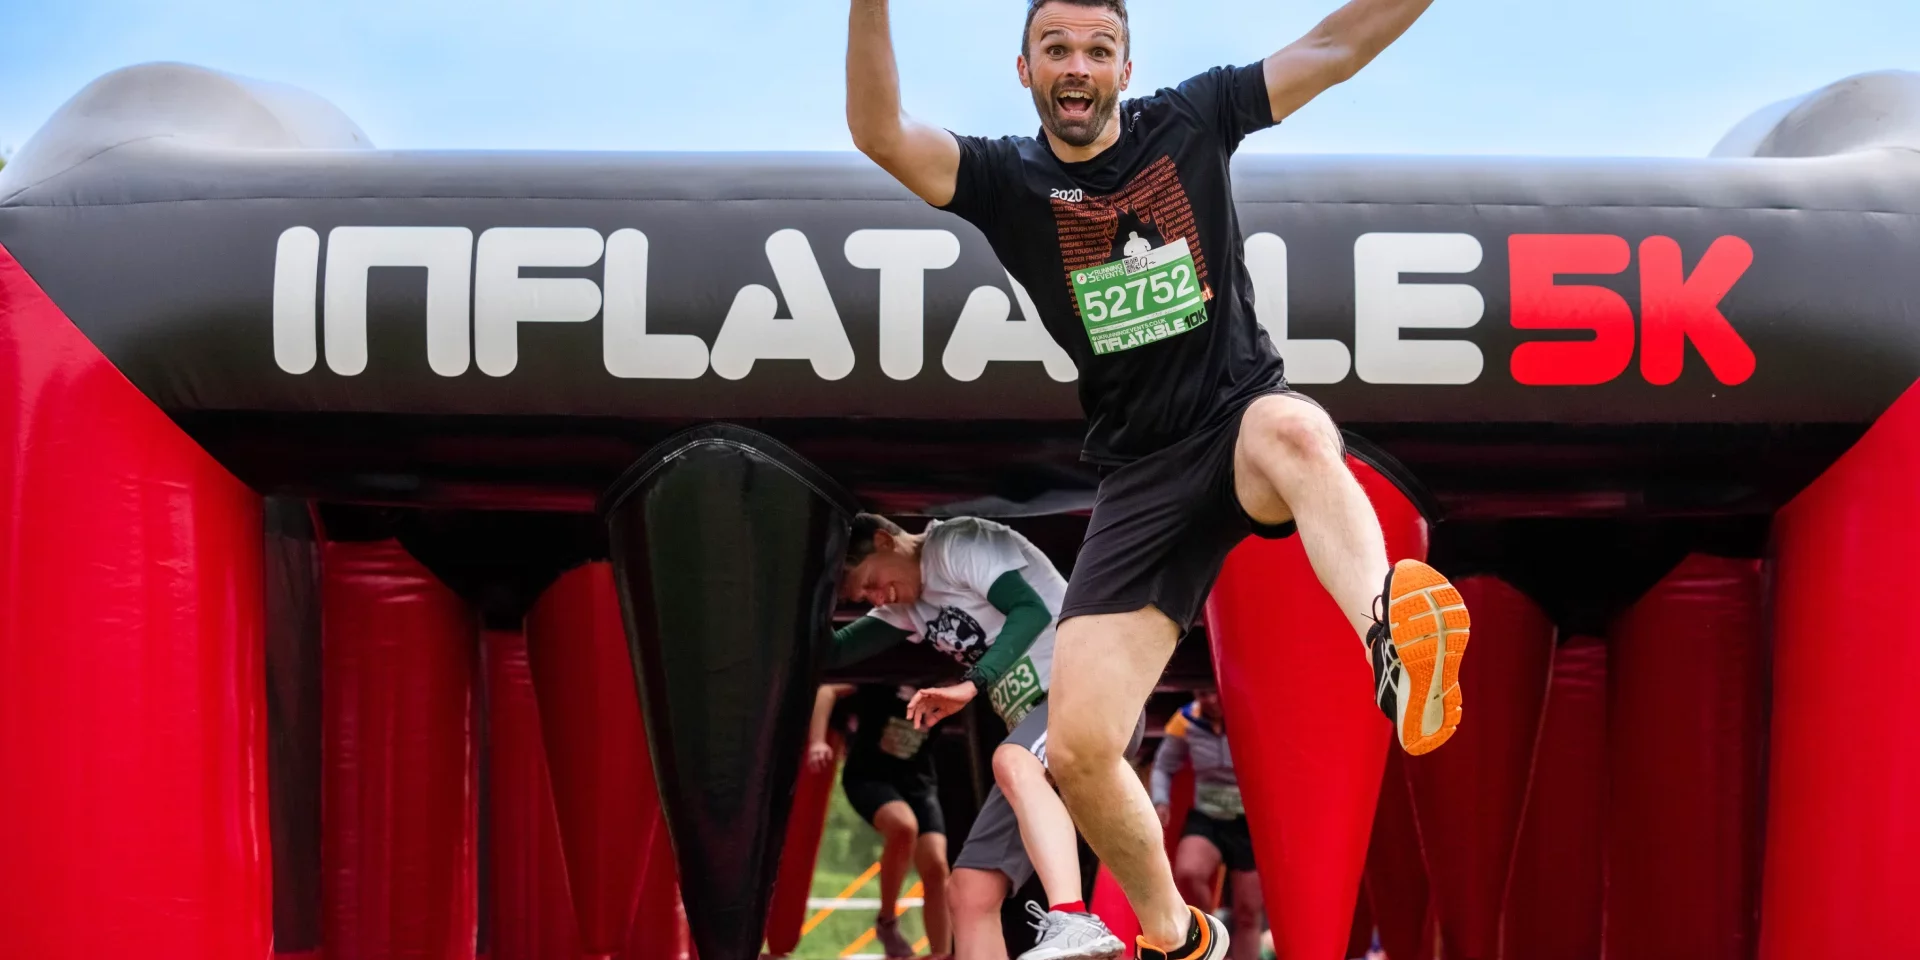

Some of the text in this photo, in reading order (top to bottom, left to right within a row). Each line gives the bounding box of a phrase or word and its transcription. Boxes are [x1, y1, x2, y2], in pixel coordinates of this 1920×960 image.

[1050, 188, 1083, 202] 2020
[1095, 264, 1123, 275] RUNNING
[1096, 270, 1125, 282] EVENTS
[1083, 264, 1195, 322] 52752
[275, 226, 1757, 386] INFLATALE 5K
